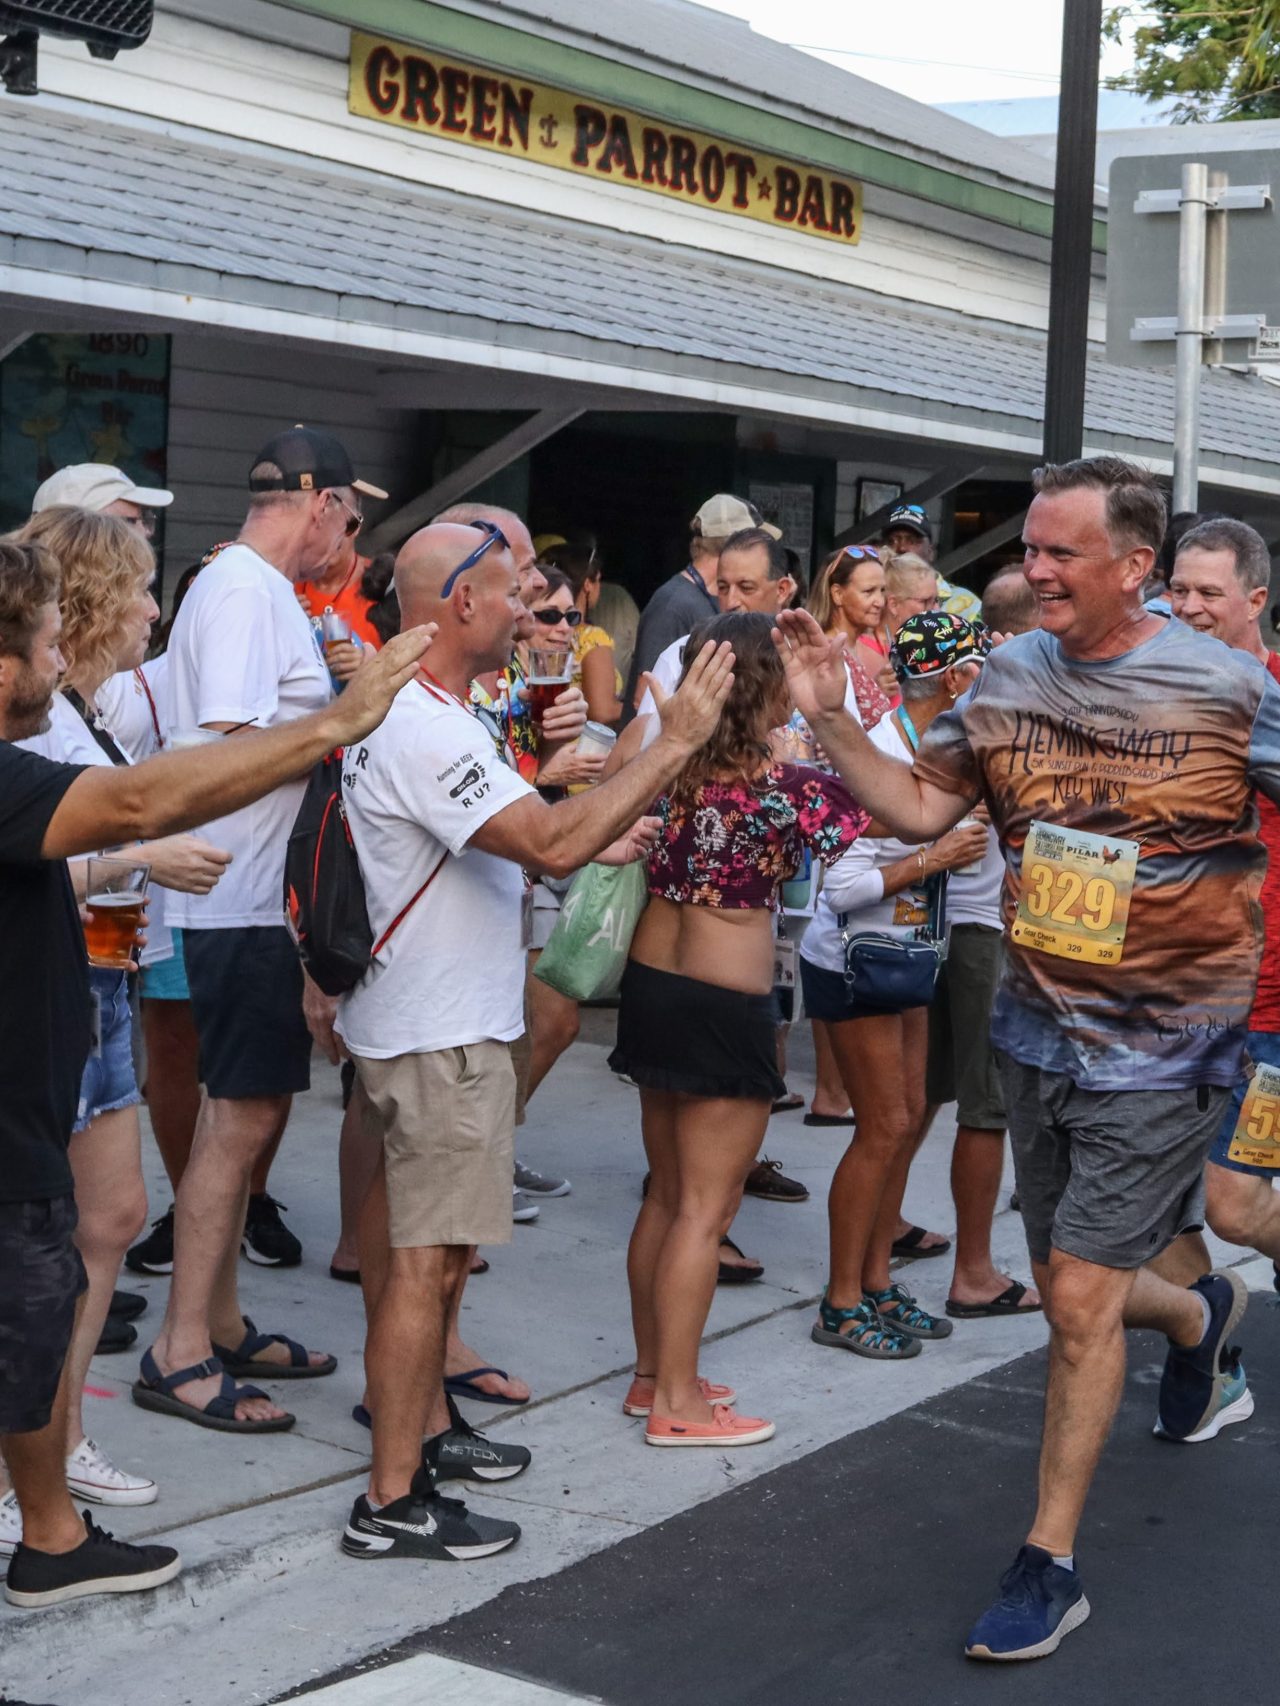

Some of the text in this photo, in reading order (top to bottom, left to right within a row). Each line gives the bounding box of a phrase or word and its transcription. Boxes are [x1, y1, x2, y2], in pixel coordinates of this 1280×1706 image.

[364, 45, 857, 238] GREEN PARROT BAR
[89, 333, 149, 357] 1890
[1008, 710, 1192, 776] HEMINGWAY
[1053, 774, 1128, 806] KEY WEST
[462, 797, 473, 808] R
[1066, 846, 1099, 859] PILAR
[1027, 863, 1117, 932] 329
[1023, 927, 1057, 944] Gear Check
[1066, 943, 1082, 953] 329
[1097, 949, 1113, 959] 329
